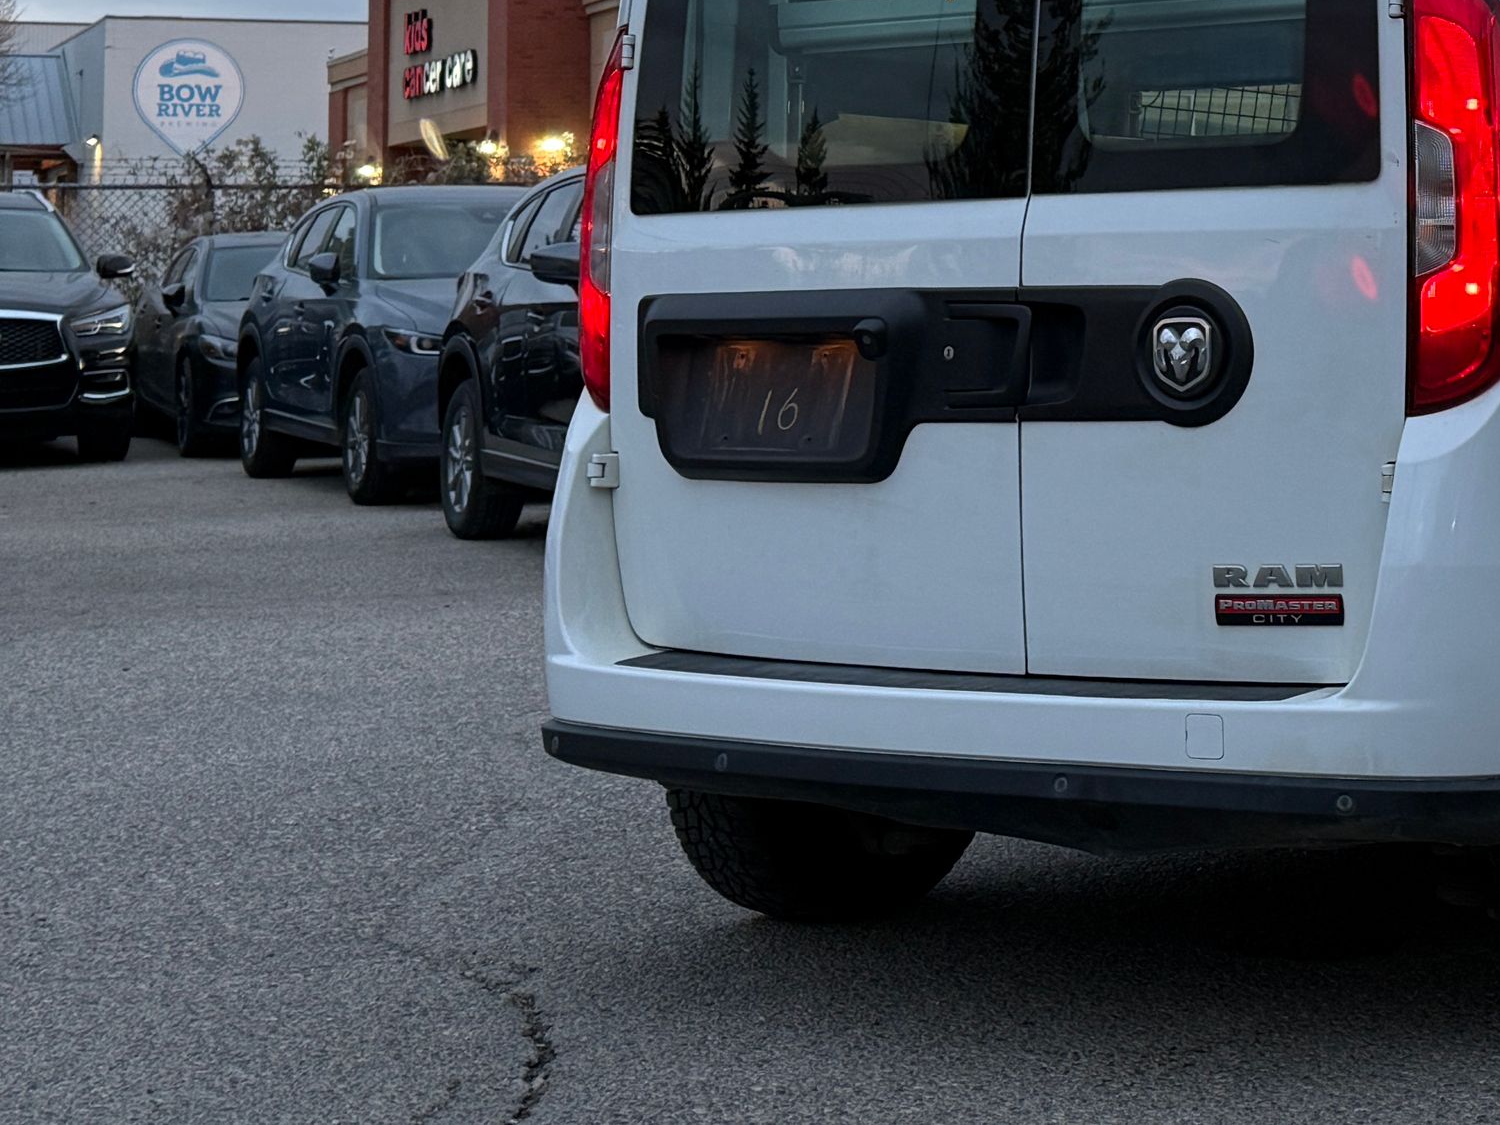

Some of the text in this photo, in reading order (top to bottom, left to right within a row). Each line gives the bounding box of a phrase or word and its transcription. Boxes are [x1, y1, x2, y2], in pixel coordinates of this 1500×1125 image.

[404, 9, 431, 55] kids
[403, 49, 476, 99] cancer care
[157, 84, 222, 102] BOW
[157, 103, 221, 117] RIVER
[757, 387, 798, 435] 16
[1213, 563, 1343, 587] RAM
[1252, 614, 1303, 623] CITY
